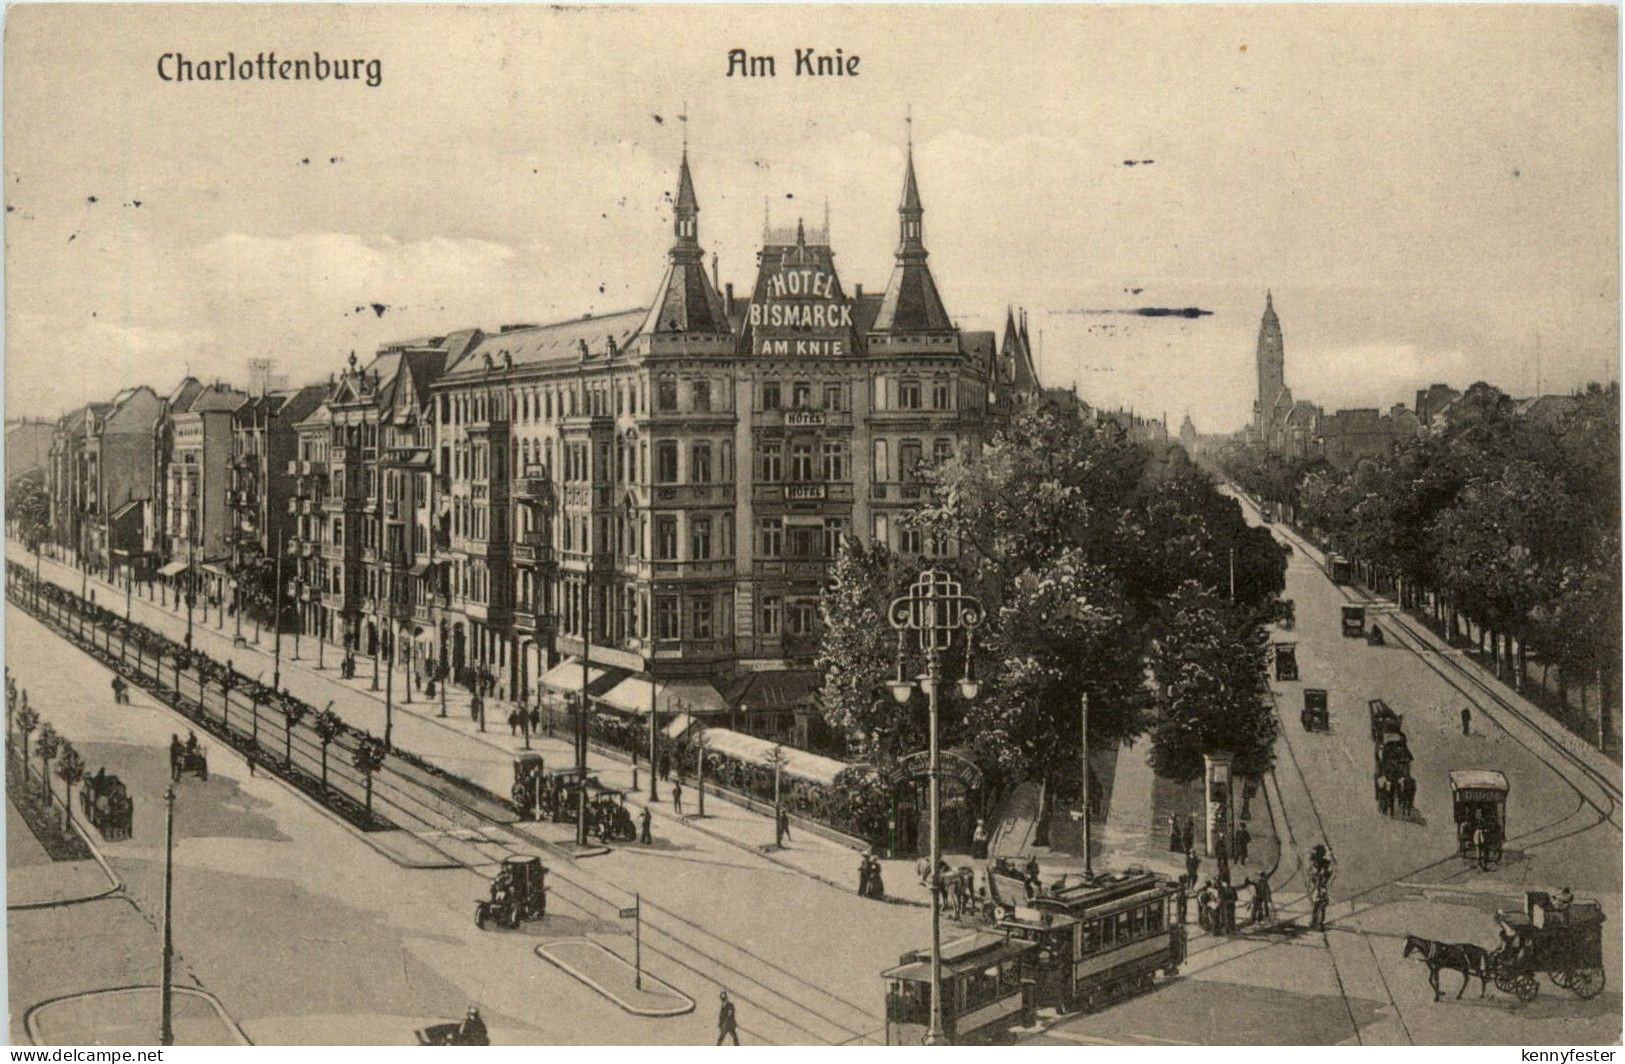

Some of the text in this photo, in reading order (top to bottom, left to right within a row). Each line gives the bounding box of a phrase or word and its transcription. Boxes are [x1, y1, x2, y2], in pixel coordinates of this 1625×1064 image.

[772, 270, 834, 299] HOTEL
[750, 304, 853, 327] BISMARCK
[762, 341, 843, 355] AM KNIE
[787, 413, 823, 425] HOTEL
[787, 487, 823, 498] HOTEL
